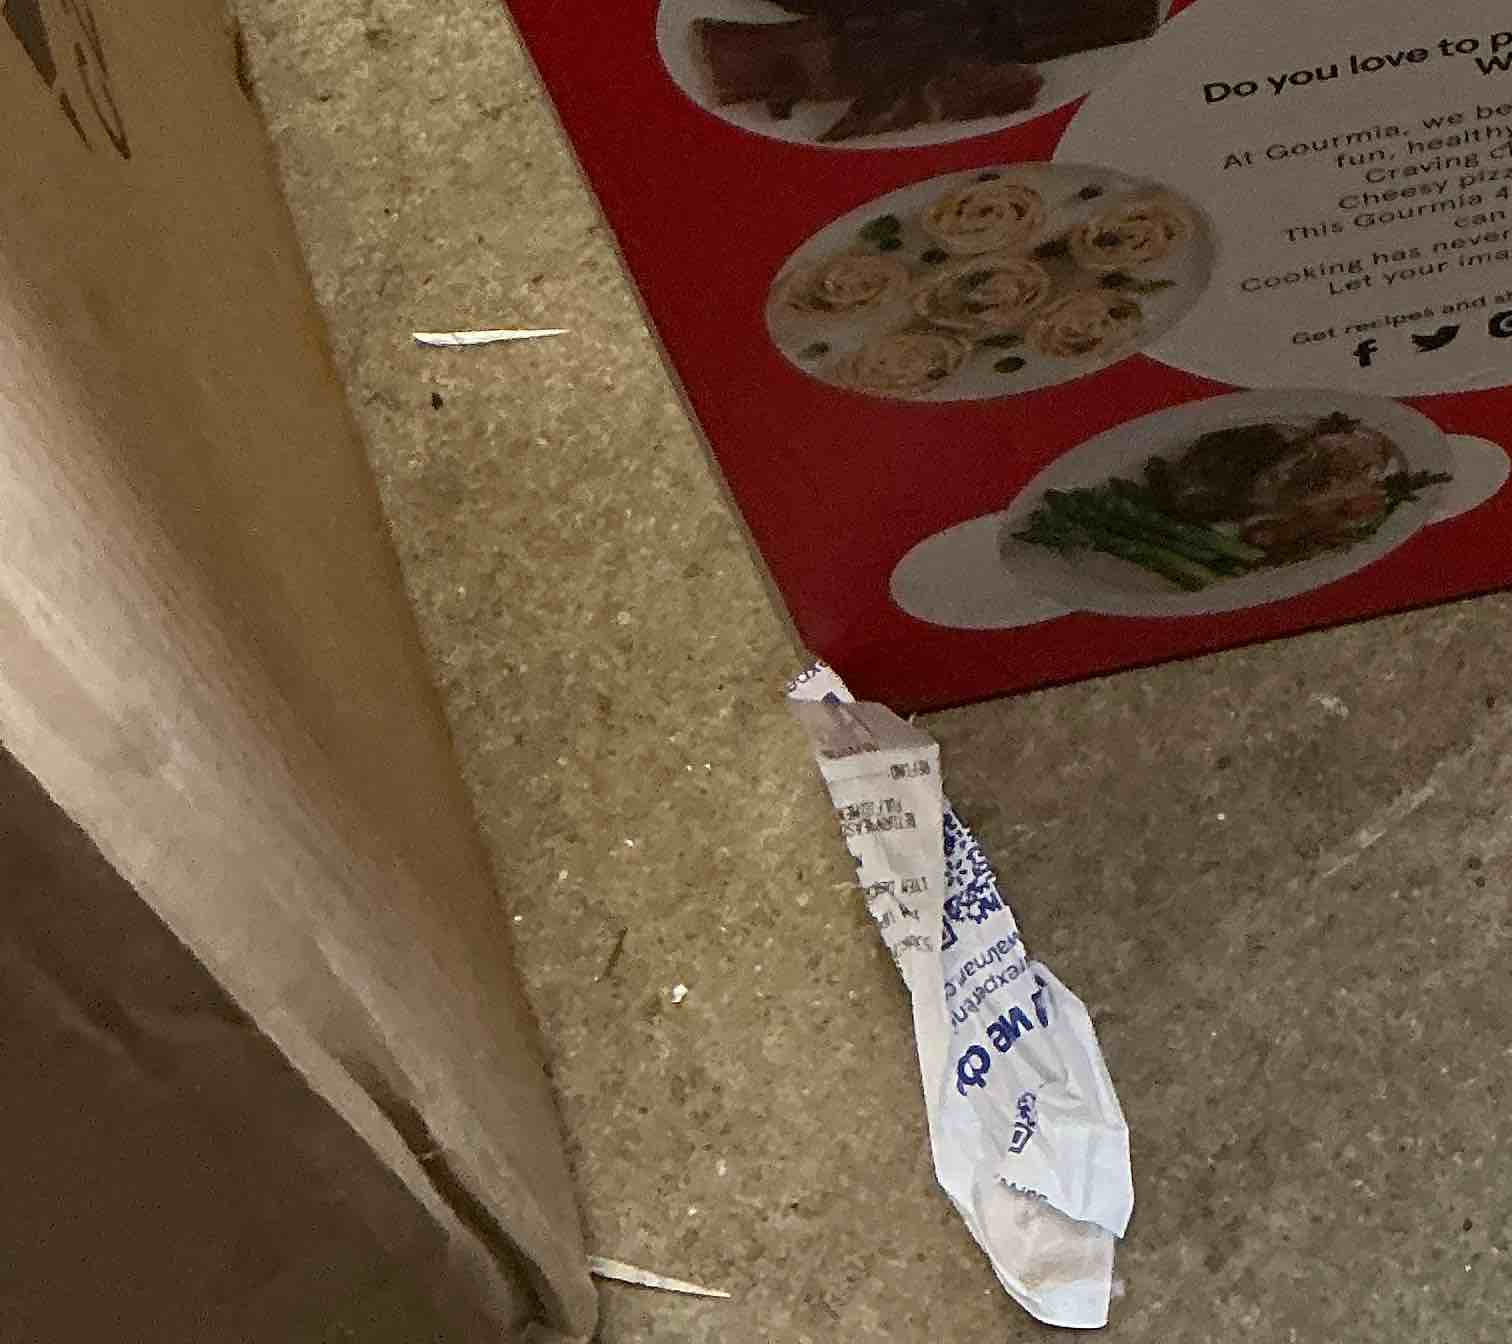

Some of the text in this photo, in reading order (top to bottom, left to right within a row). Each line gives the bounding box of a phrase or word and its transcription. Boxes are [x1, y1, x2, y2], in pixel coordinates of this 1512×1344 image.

[1203, 81, 1258, 104] Do
[1267, 64, 1338, 94] you
[1349, 48, 1429, 75] love
[1438, 38, 1480, 57] to
[1223, 151, 1253, 170] At
[1422, 113, 1463, 129] we
[1365, 153, 1479, 184] Craving
[1338, 180, 1448, 210] Cheesy
[1286, 223, 1343, 242] This
[1353, 194, 1482, 228] Gourmia
[1454, 210, 1506, 229] can
[1241, 259, 1363, 292] Cooking
[1372, 247, 1421, 265] has
[1433, 230, 1510, 253] never
[1329, 274, 1372, 296] Let
[1383, 261, 1448, 285] your
